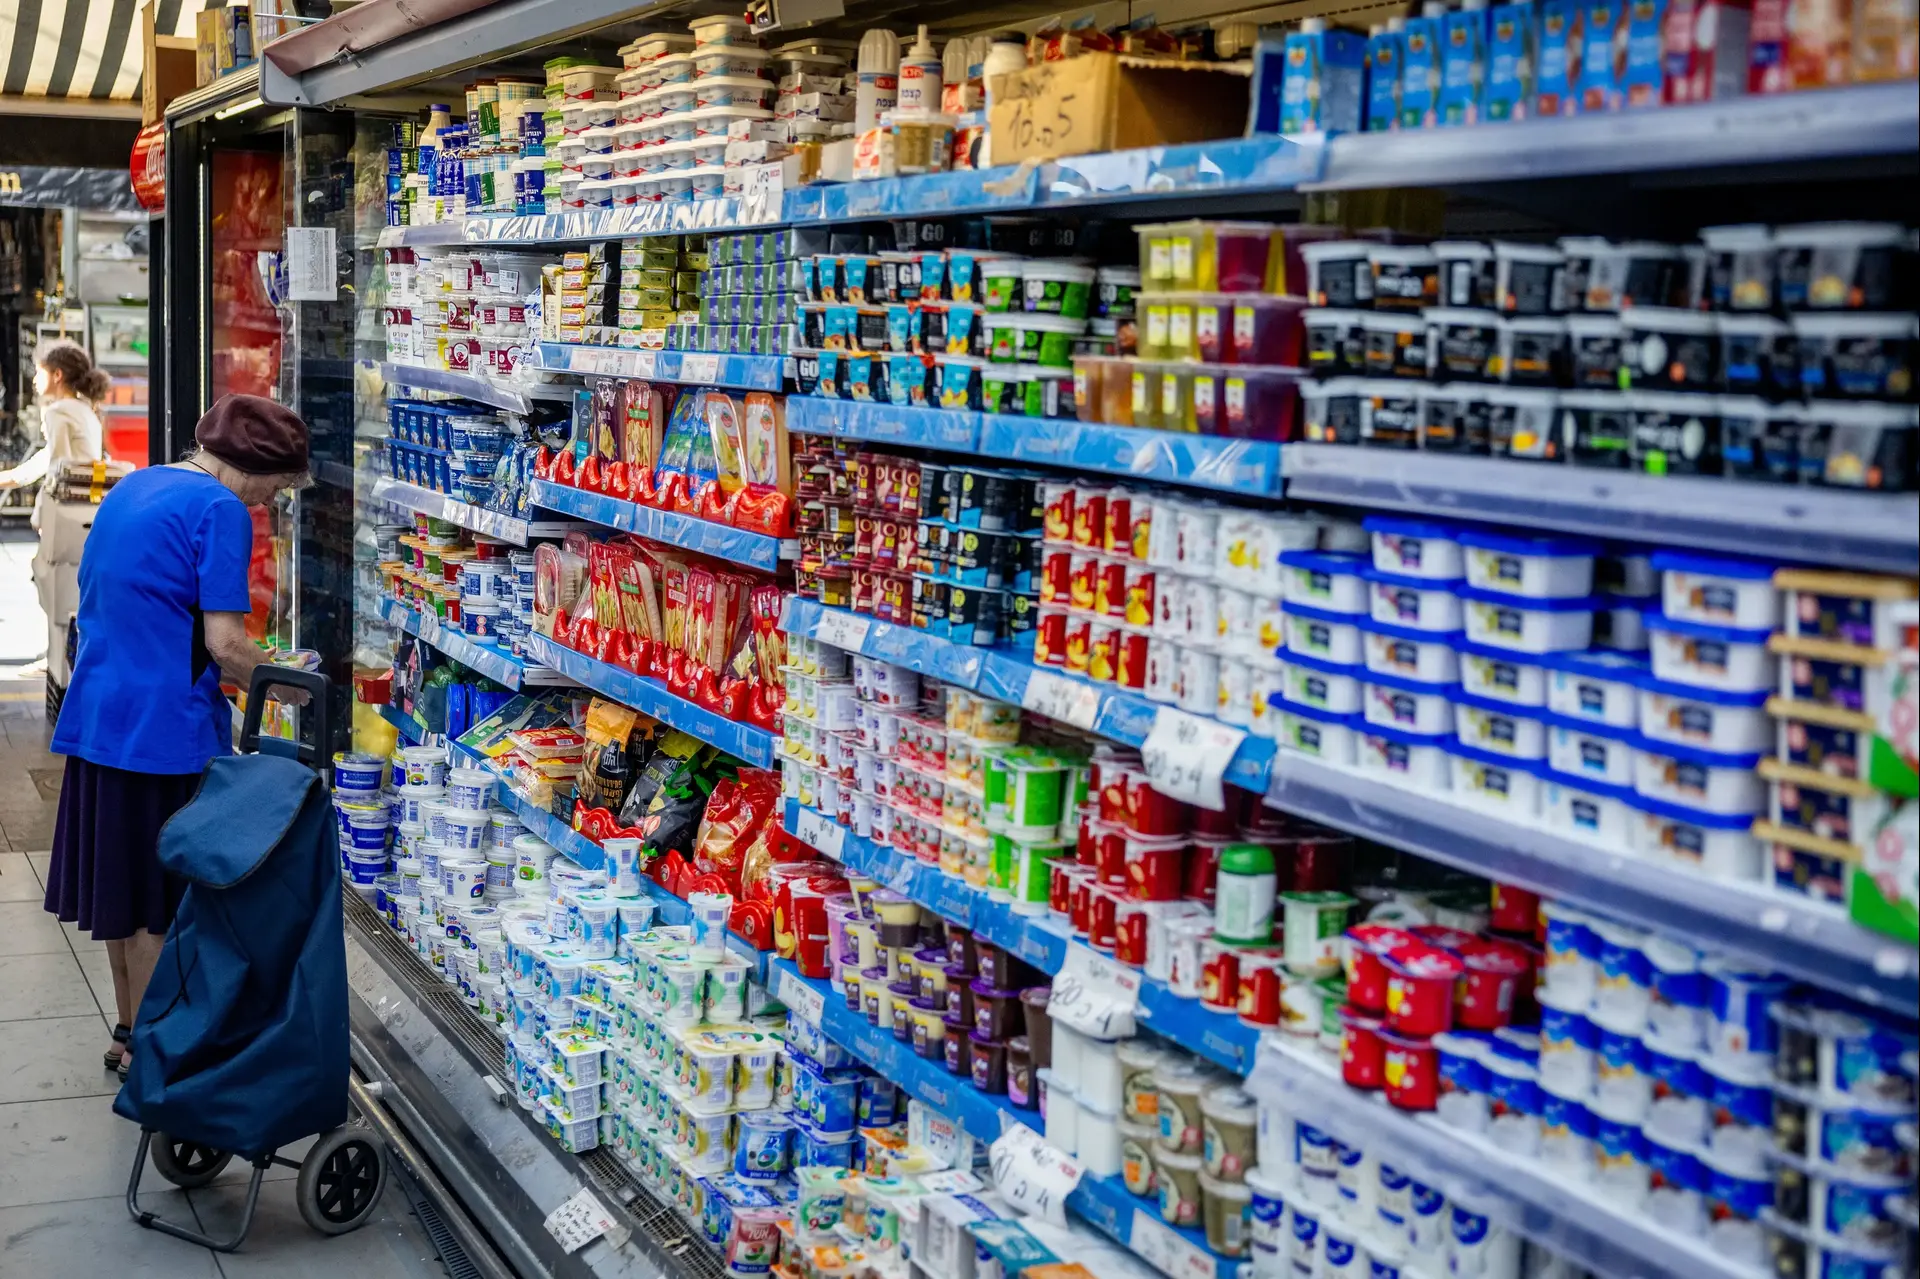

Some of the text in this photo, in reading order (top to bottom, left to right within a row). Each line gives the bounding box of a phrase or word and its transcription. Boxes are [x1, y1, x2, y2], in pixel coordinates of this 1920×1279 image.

[921, 224, 944, 242] GO
[899, 263, 922, 285] GO
[800, 359, 819, 378] GO
